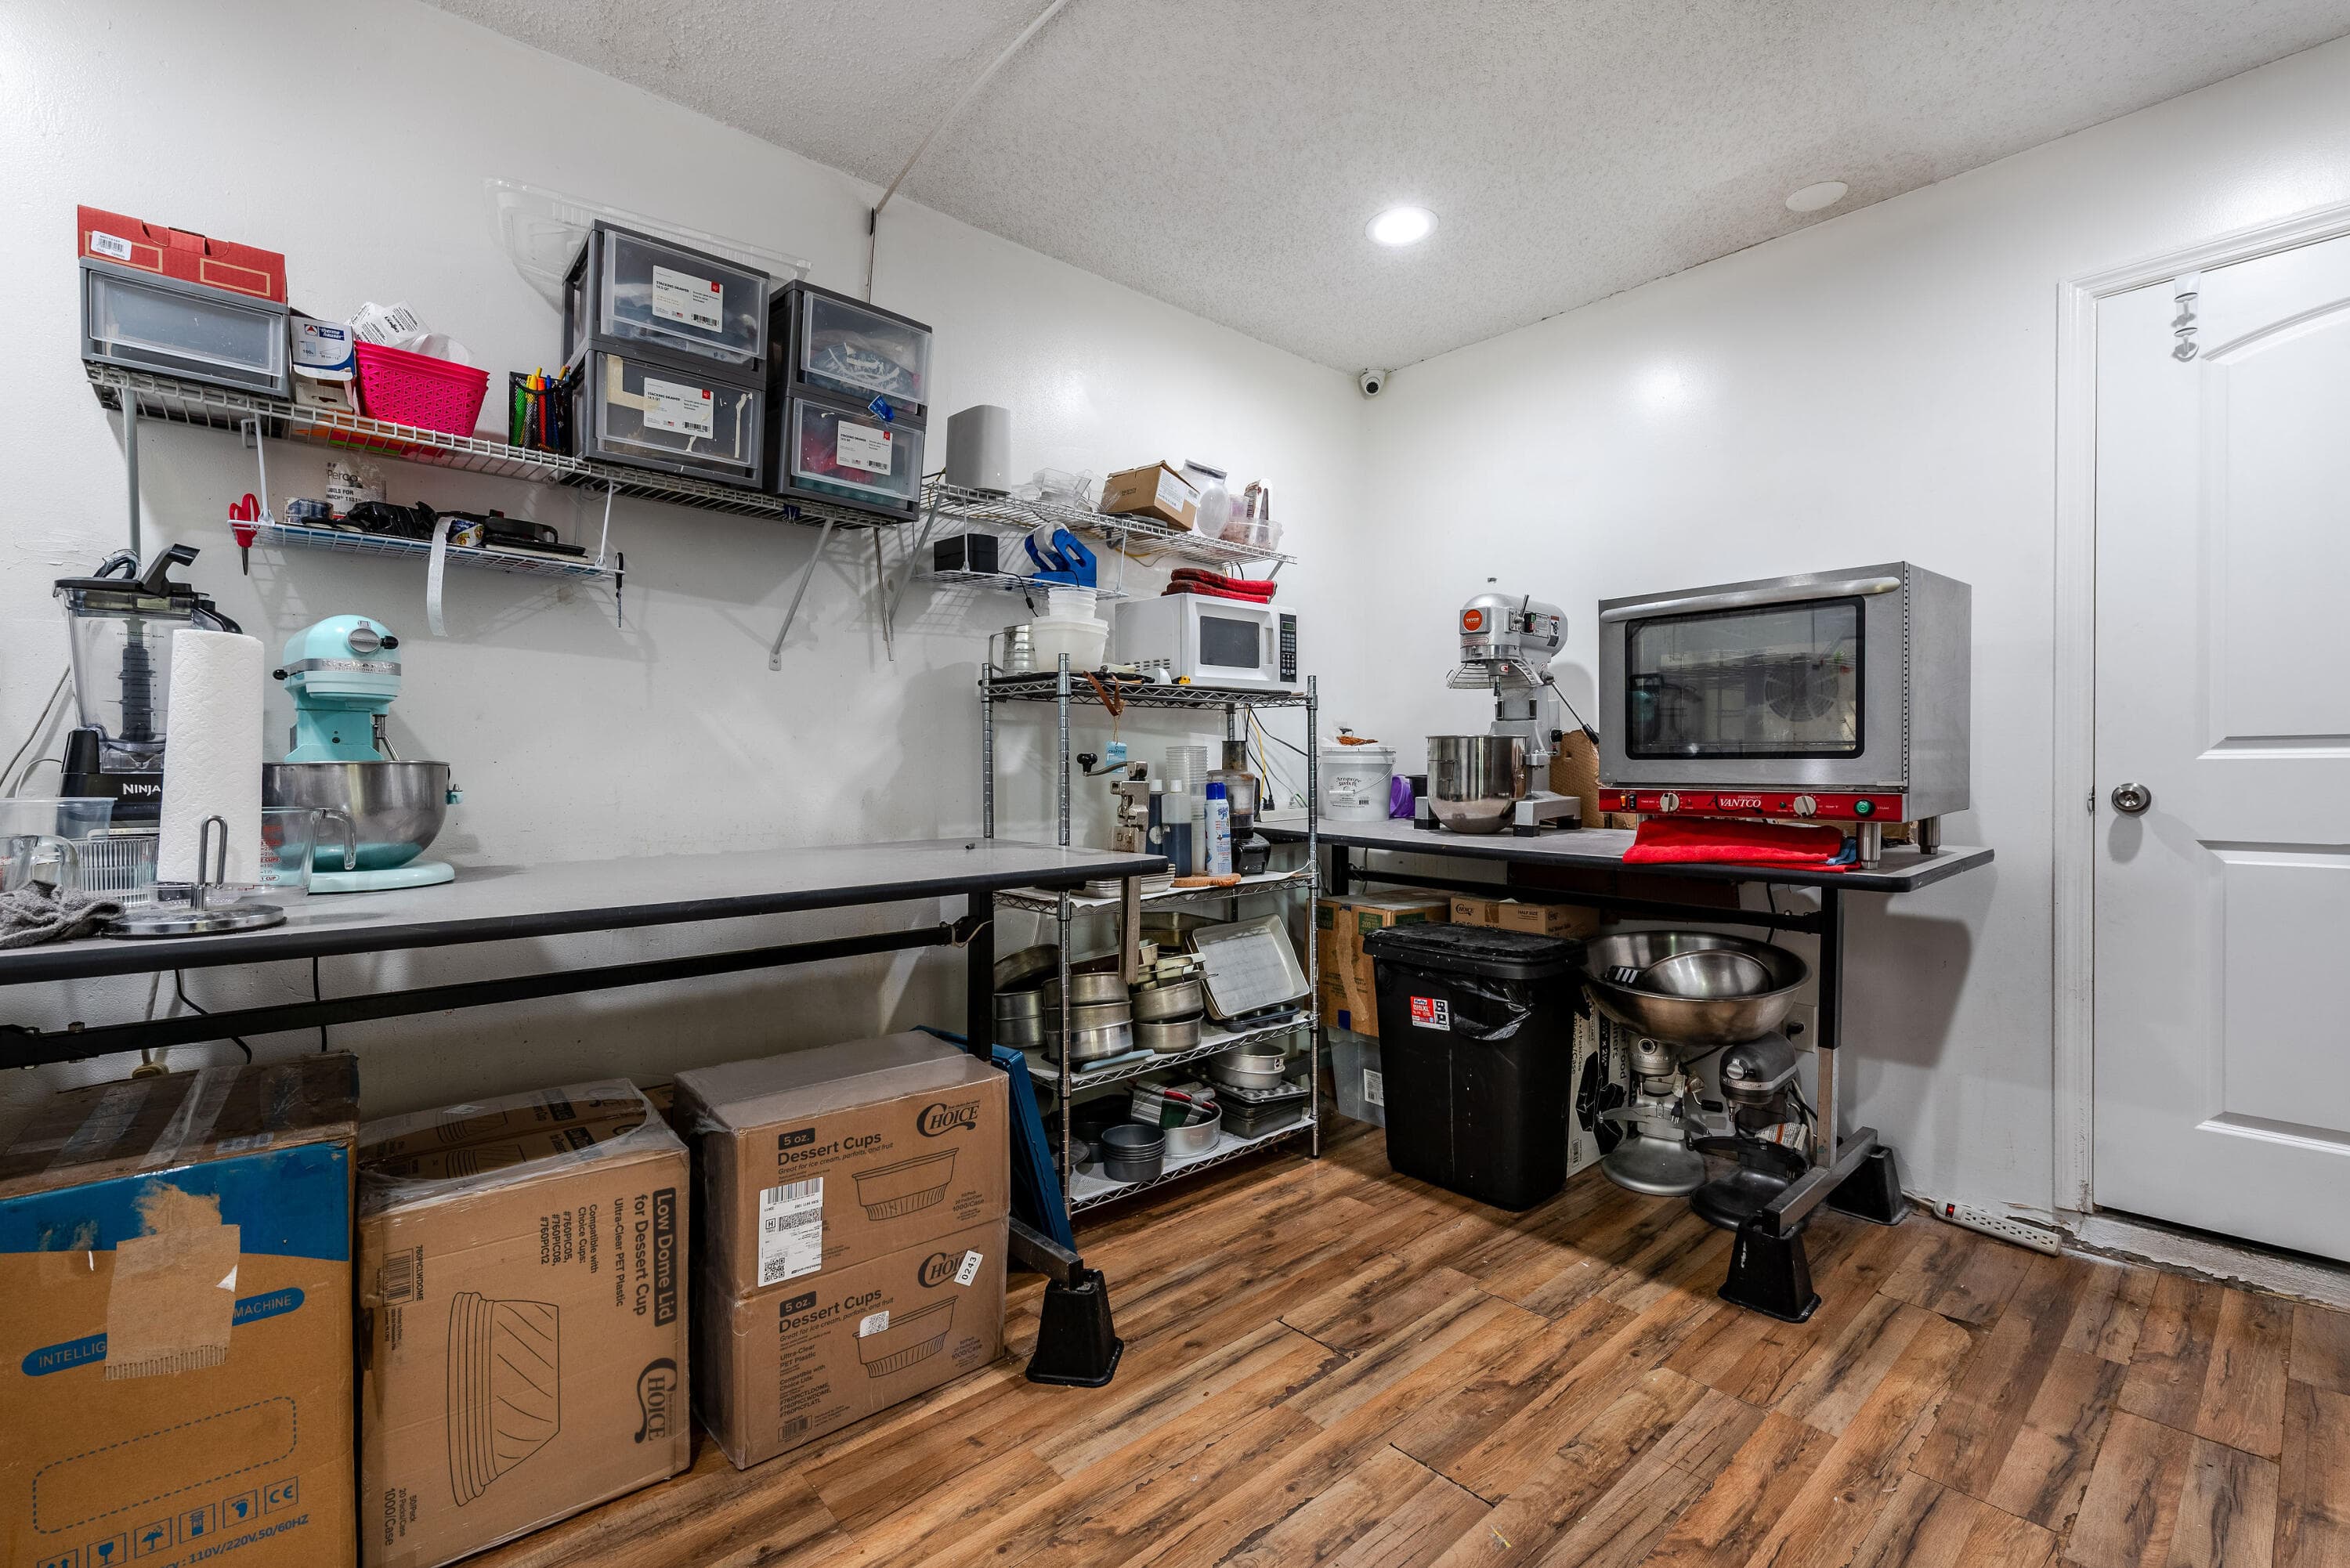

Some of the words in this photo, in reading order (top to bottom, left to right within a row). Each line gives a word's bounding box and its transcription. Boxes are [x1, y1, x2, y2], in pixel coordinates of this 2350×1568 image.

[122, 782, 161, 796] NINJA
[1619, 1047, 1628, 1078] Food
[916, 1103, 980, 1137] CHOICE
[778, 1140, 839, 1165] Dessert
[844, 1133, 881, 1150] Cups
[784, 1136, 791, 1146] 5
[794, 1134, 810, 1143] oz.
[778, 1164, 797, 1174] Great
[869, 1145, 881, 1154] and
[634, 1194, 649, 1216] for
[656, 1194, 673, 1230] Low
[578, 1206, 587, 1237] Choice
[589, 1203, 598, 1253] Compatible
[614, 1198, 624, 1251] Ultra-Clear
[540, 1216, 550, 1265] #760PIC12
[577, 1238, 587, 1264] Cups:
[634, 1219, 649, 1281] Dessert
[590, 1254, 599, 1274] with
[615, 1252, 625, 1272] PET
[657, 1234, 674, 1288] Dome
[917, 1252, 965, 1288] CHOI
[961, 1256, 977, 1280] 0243
[616, 1274, 626, 1307] Plastic
[633, 1283, 649, 1317] Cup
[659, 1290, 675, 1321] Lid
[786, 1302, 793, 1313] 5
[795, 1299, 811, 1309] oz.
[233, 1294, 293, 1319] MACHINE
[779, 1302, 841, 1334] Dessert
[844, 1289, 882, 1310] Cups
[779, 1331, 798, 1342] Great
[39, 1340, 107, 1368] INTELLIG
[780, 1345, 815, 1360] Ultra-Clear
[780, 1360, 793, 1368] PET
[794, 1352, 816, 1363] Plastic
[779, 1369, 812, 1386] Compatible
[813, 1364, 826, 1373] with
[779, 1381, 799, 1392] Choice
[634, 1357, 678, 1443] CHOICE
[385, 1488, 396, 1546] 1000/Case
